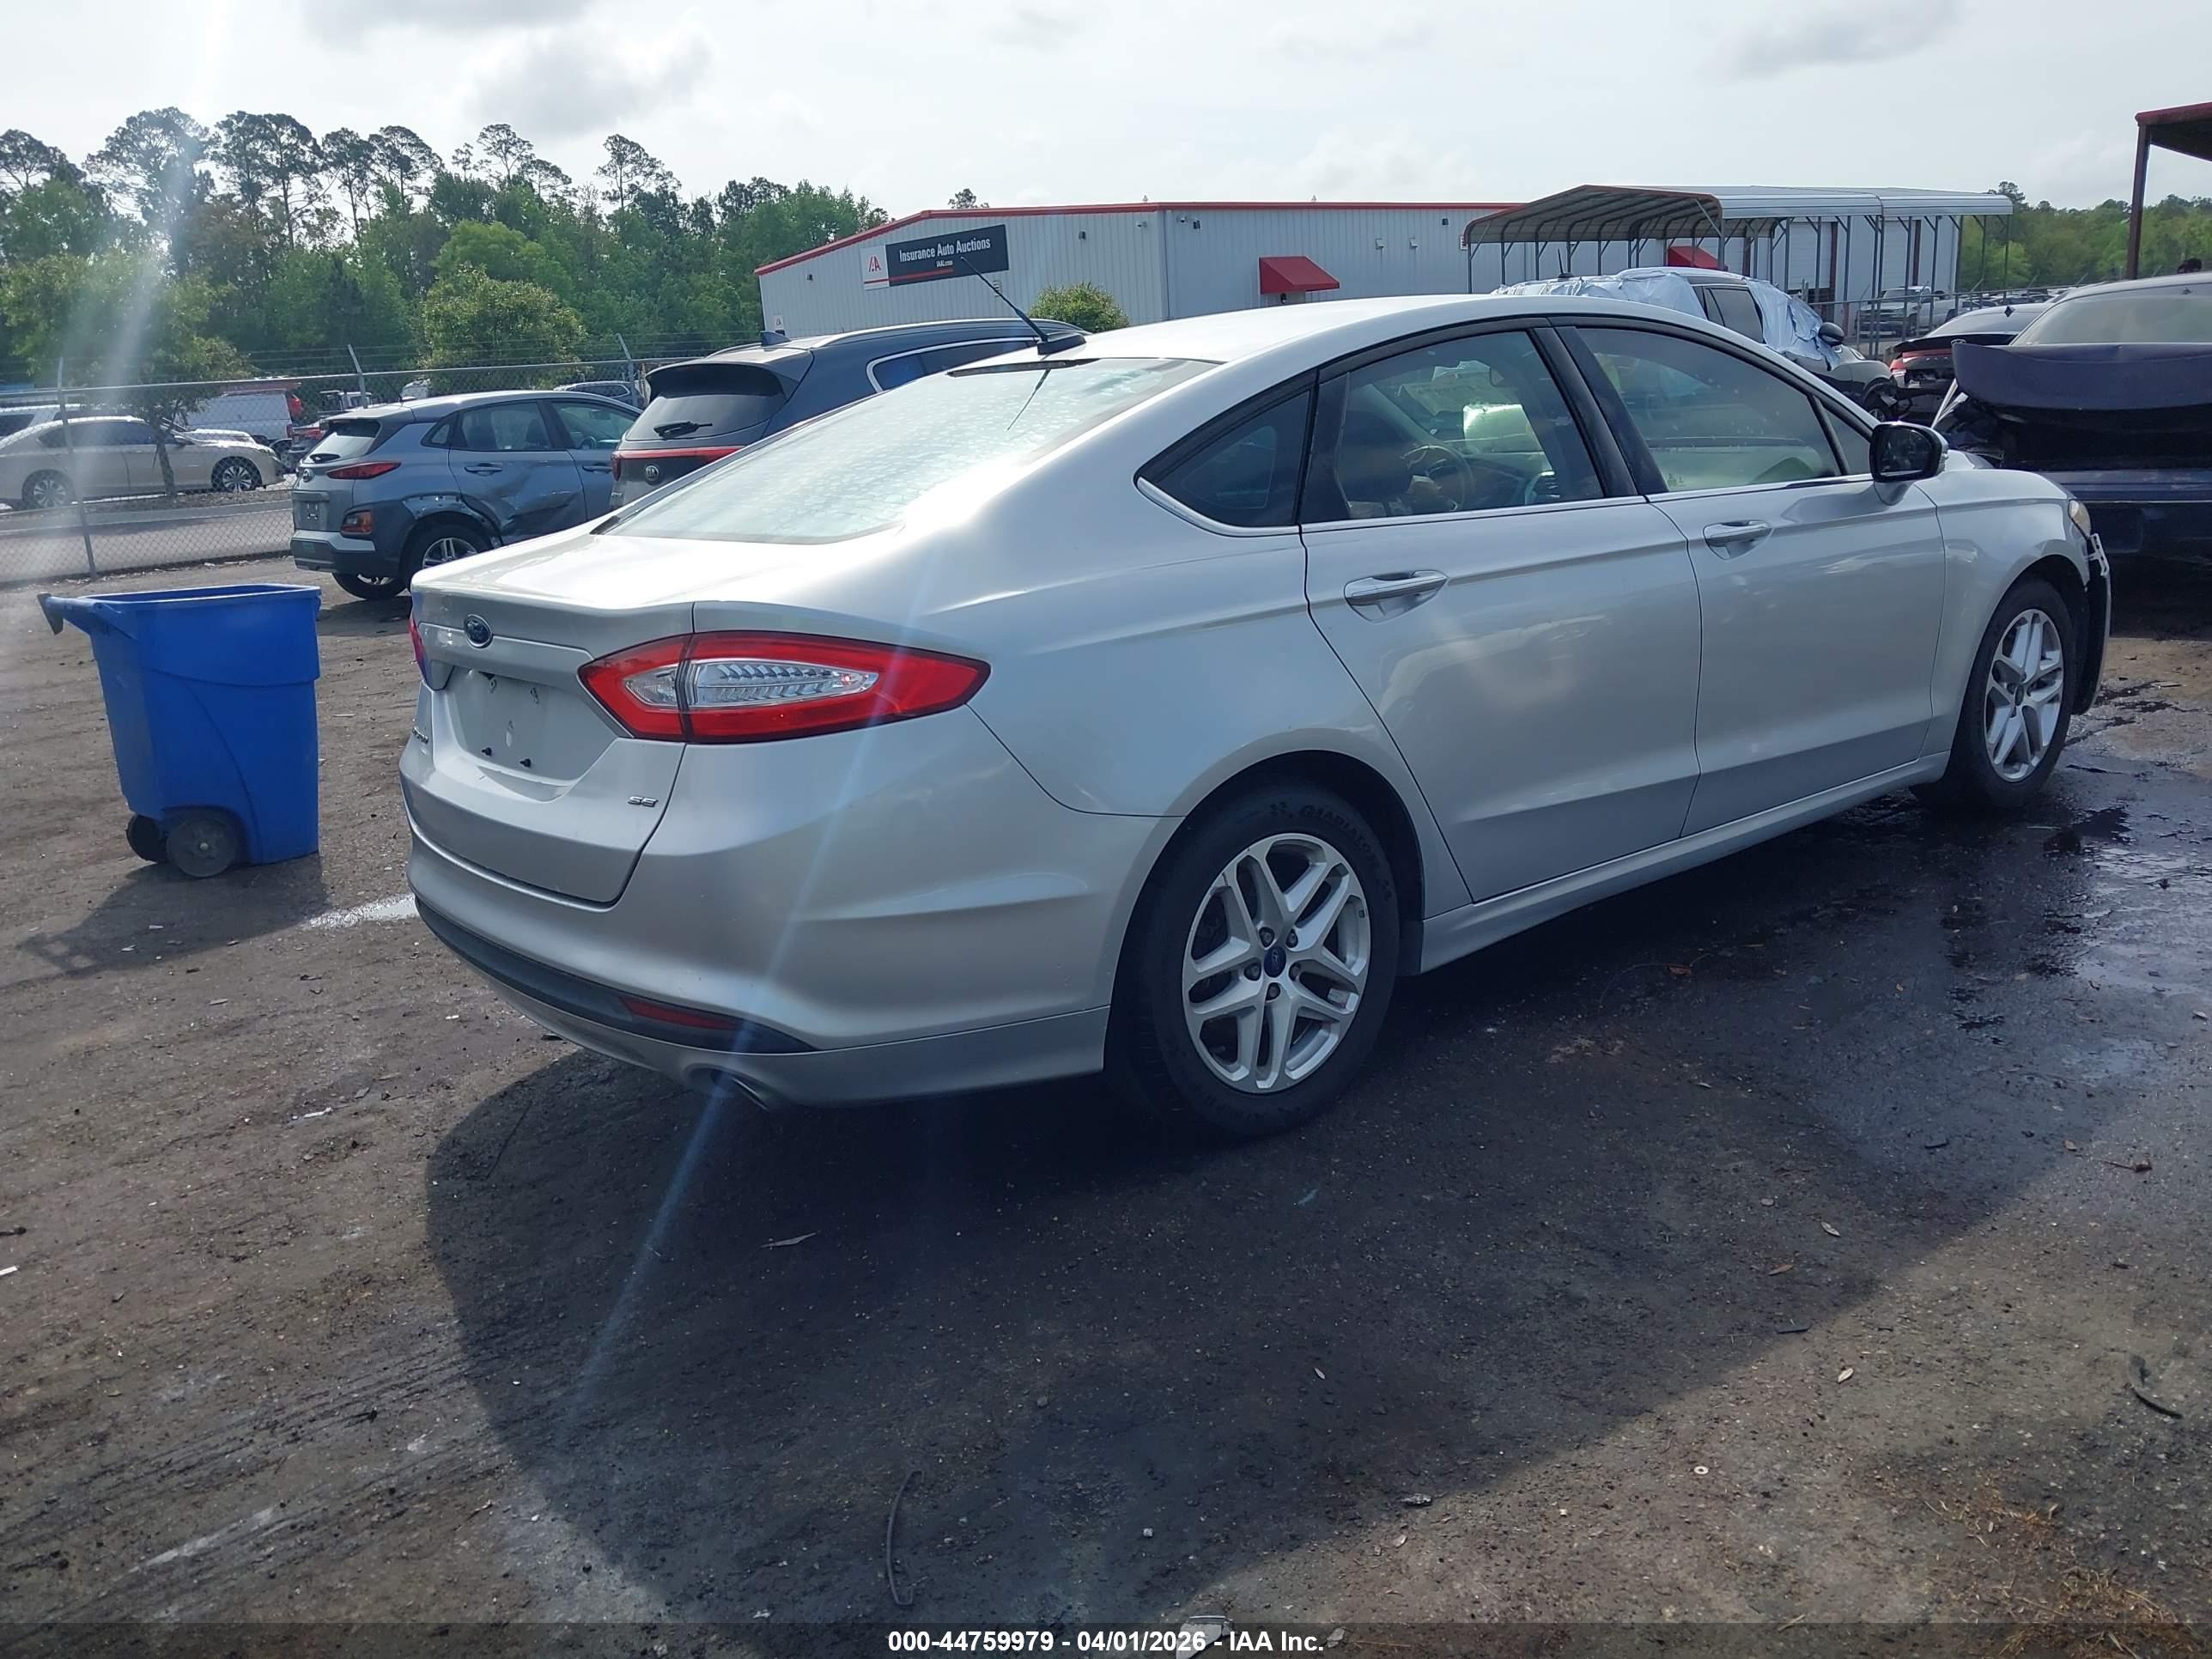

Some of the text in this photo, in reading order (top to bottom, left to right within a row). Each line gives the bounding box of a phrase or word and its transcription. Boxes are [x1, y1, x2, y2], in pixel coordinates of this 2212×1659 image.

[899, 237, 991, 263] Insurance Auto Auctions
[627, 795, 659, 808] SE
